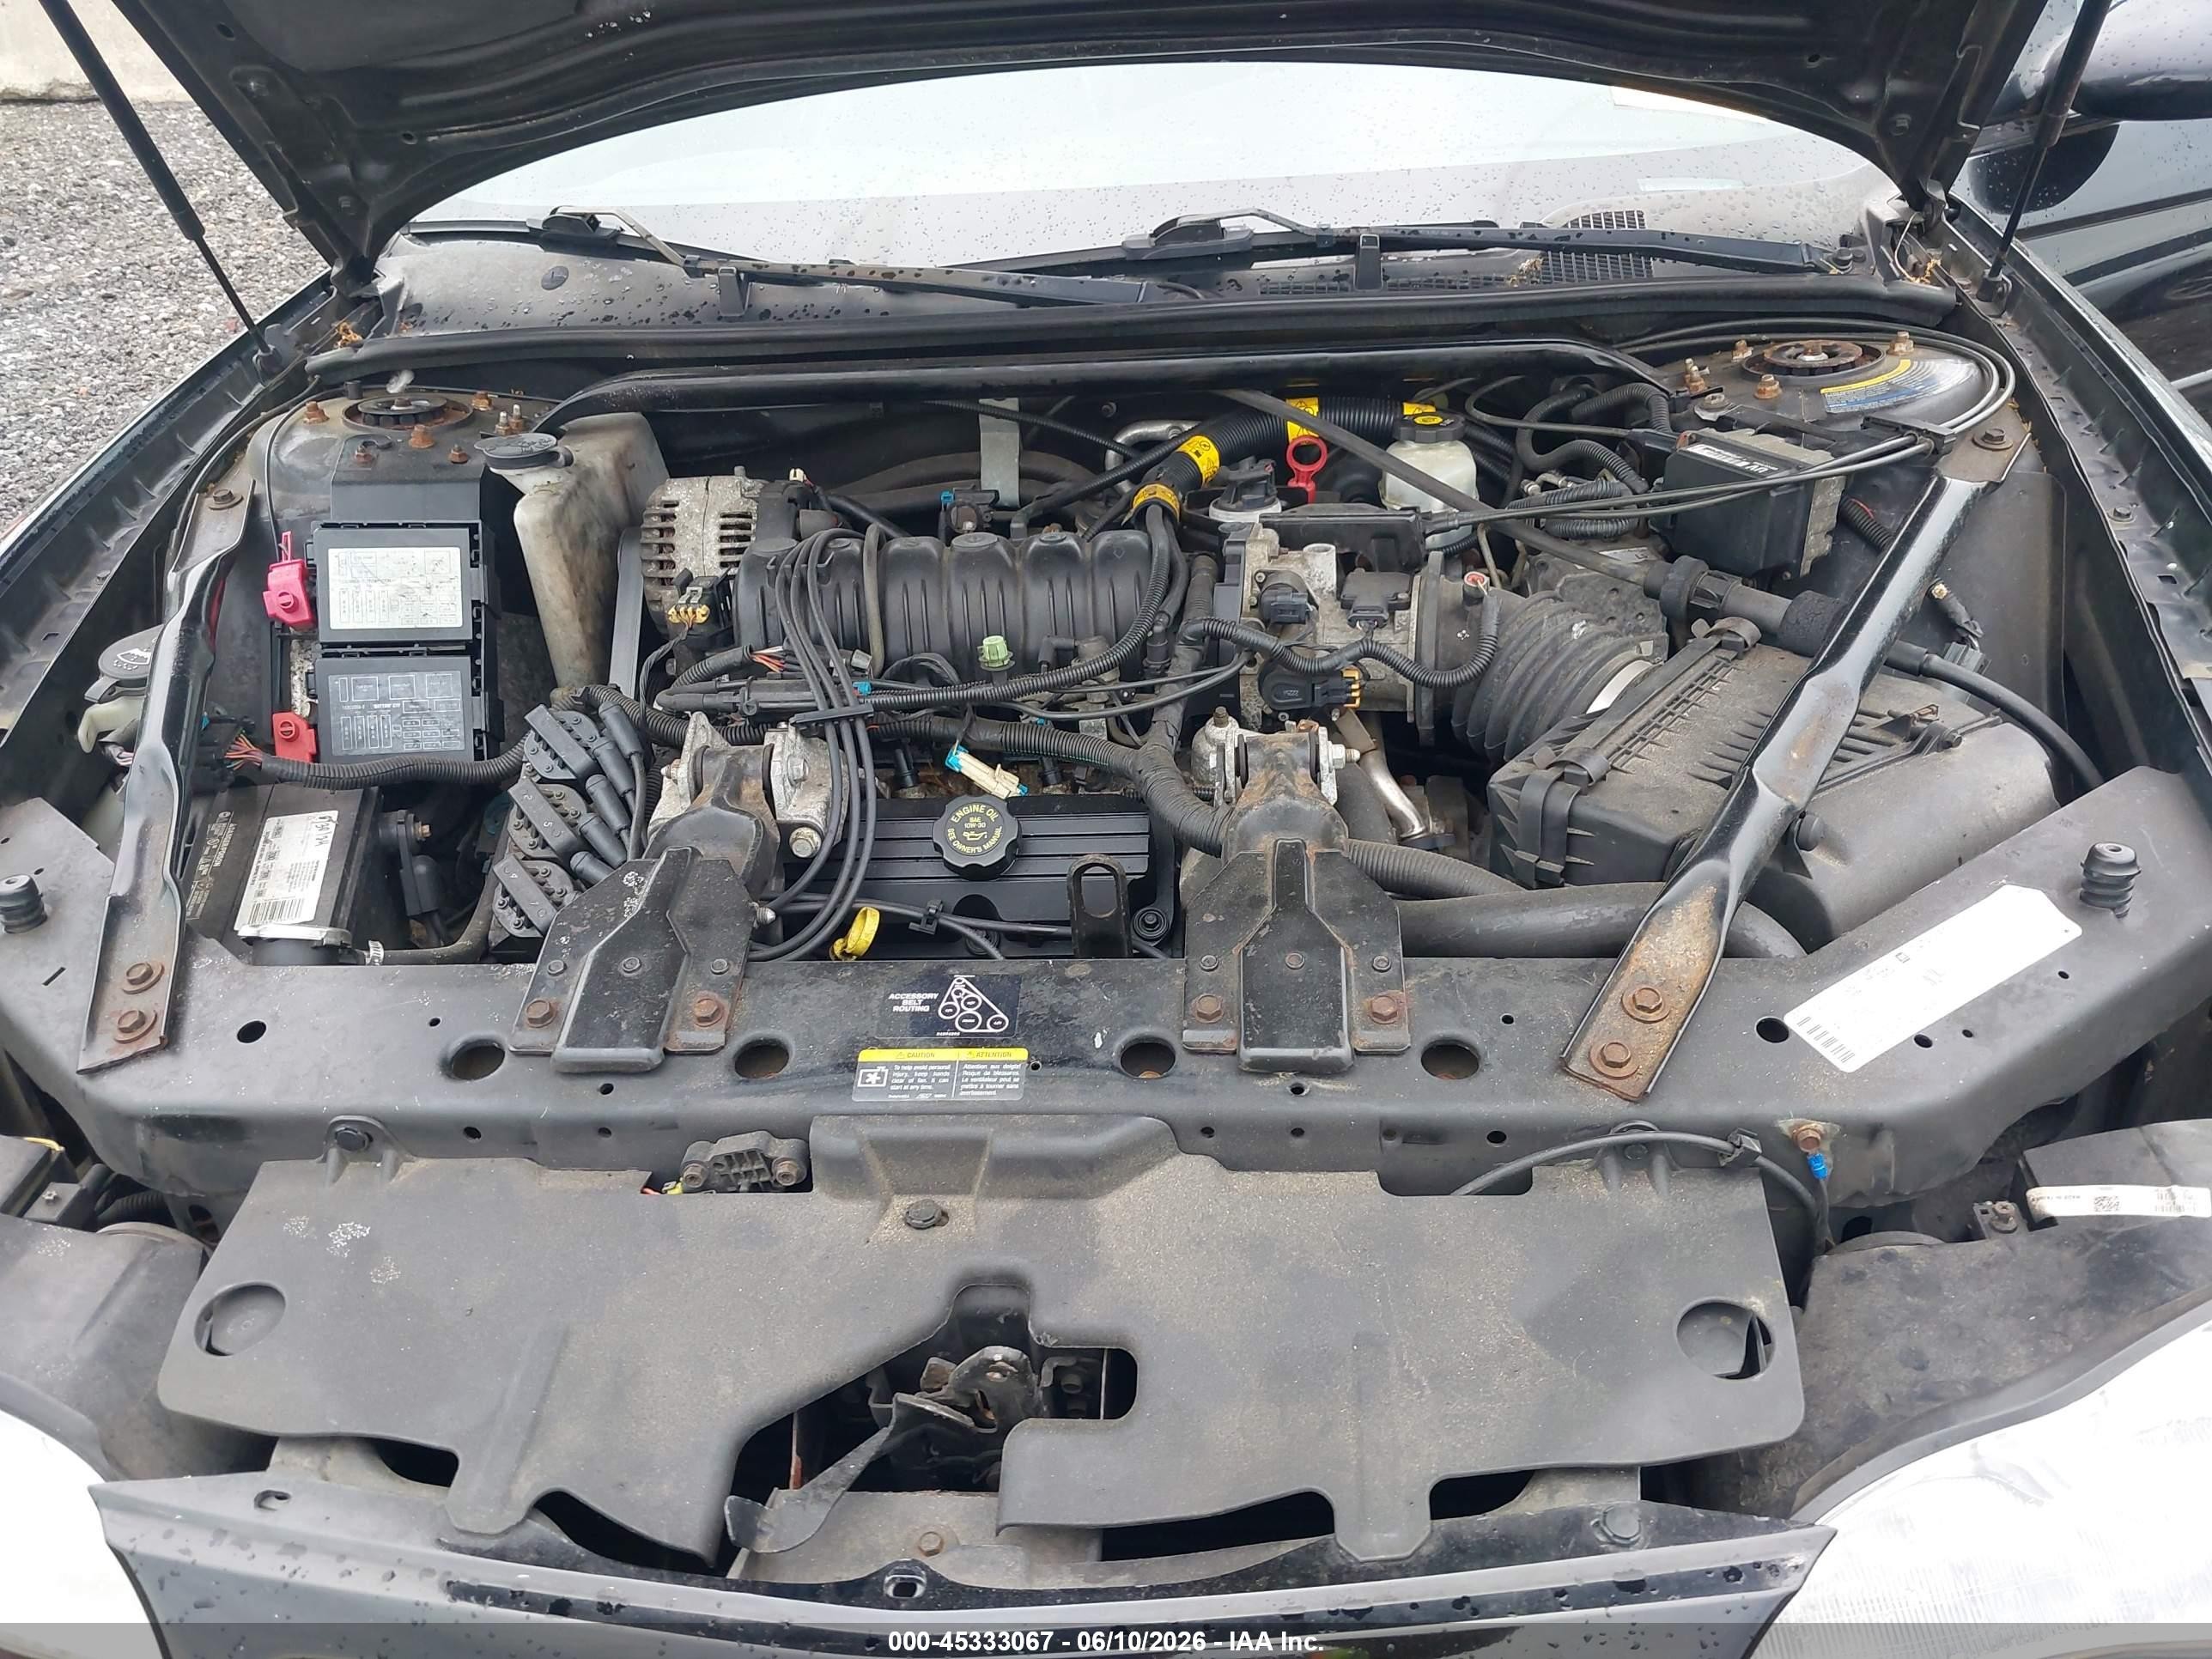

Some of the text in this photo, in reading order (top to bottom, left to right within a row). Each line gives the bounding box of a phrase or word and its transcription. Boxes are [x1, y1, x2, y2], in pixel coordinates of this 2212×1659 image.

[951, 804, 999, 823] ENGINE OIL
[947, 825, 1002, 854] SEE OWNER'S MANUAL
